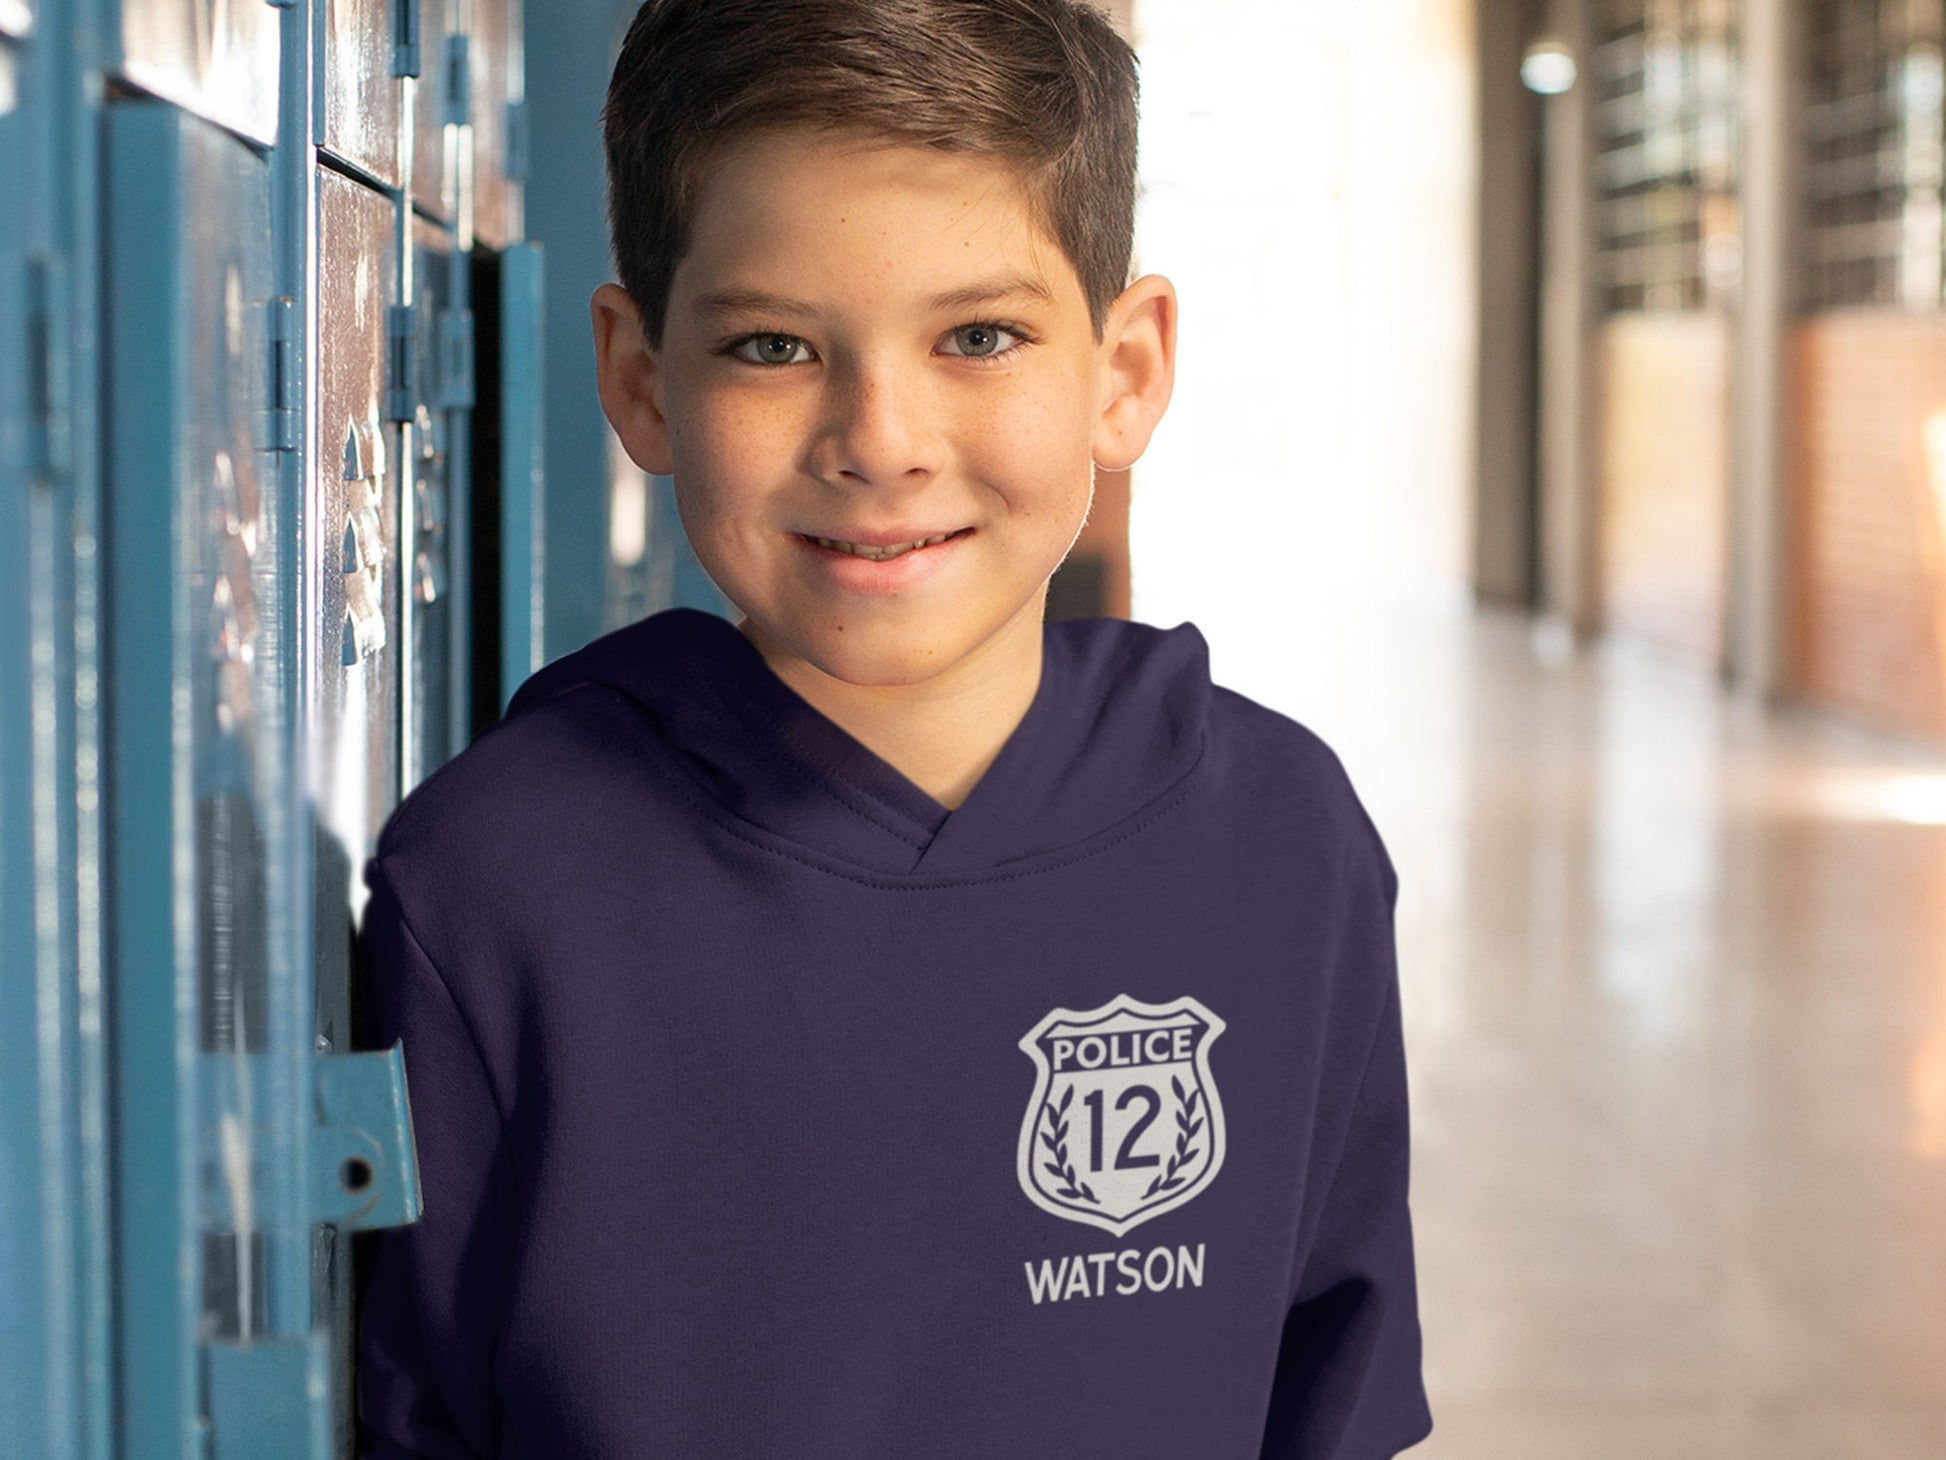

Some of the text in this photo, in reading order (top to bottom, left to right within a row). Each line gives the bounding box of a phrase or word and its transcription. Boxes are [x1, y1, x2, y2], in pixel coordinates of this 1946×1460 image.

[1053, 1028, 1192, 1070] POLICE
[1084, 1084, 1161, 1172] 12
[1024, 1243, 1205, 1305] WATSON
